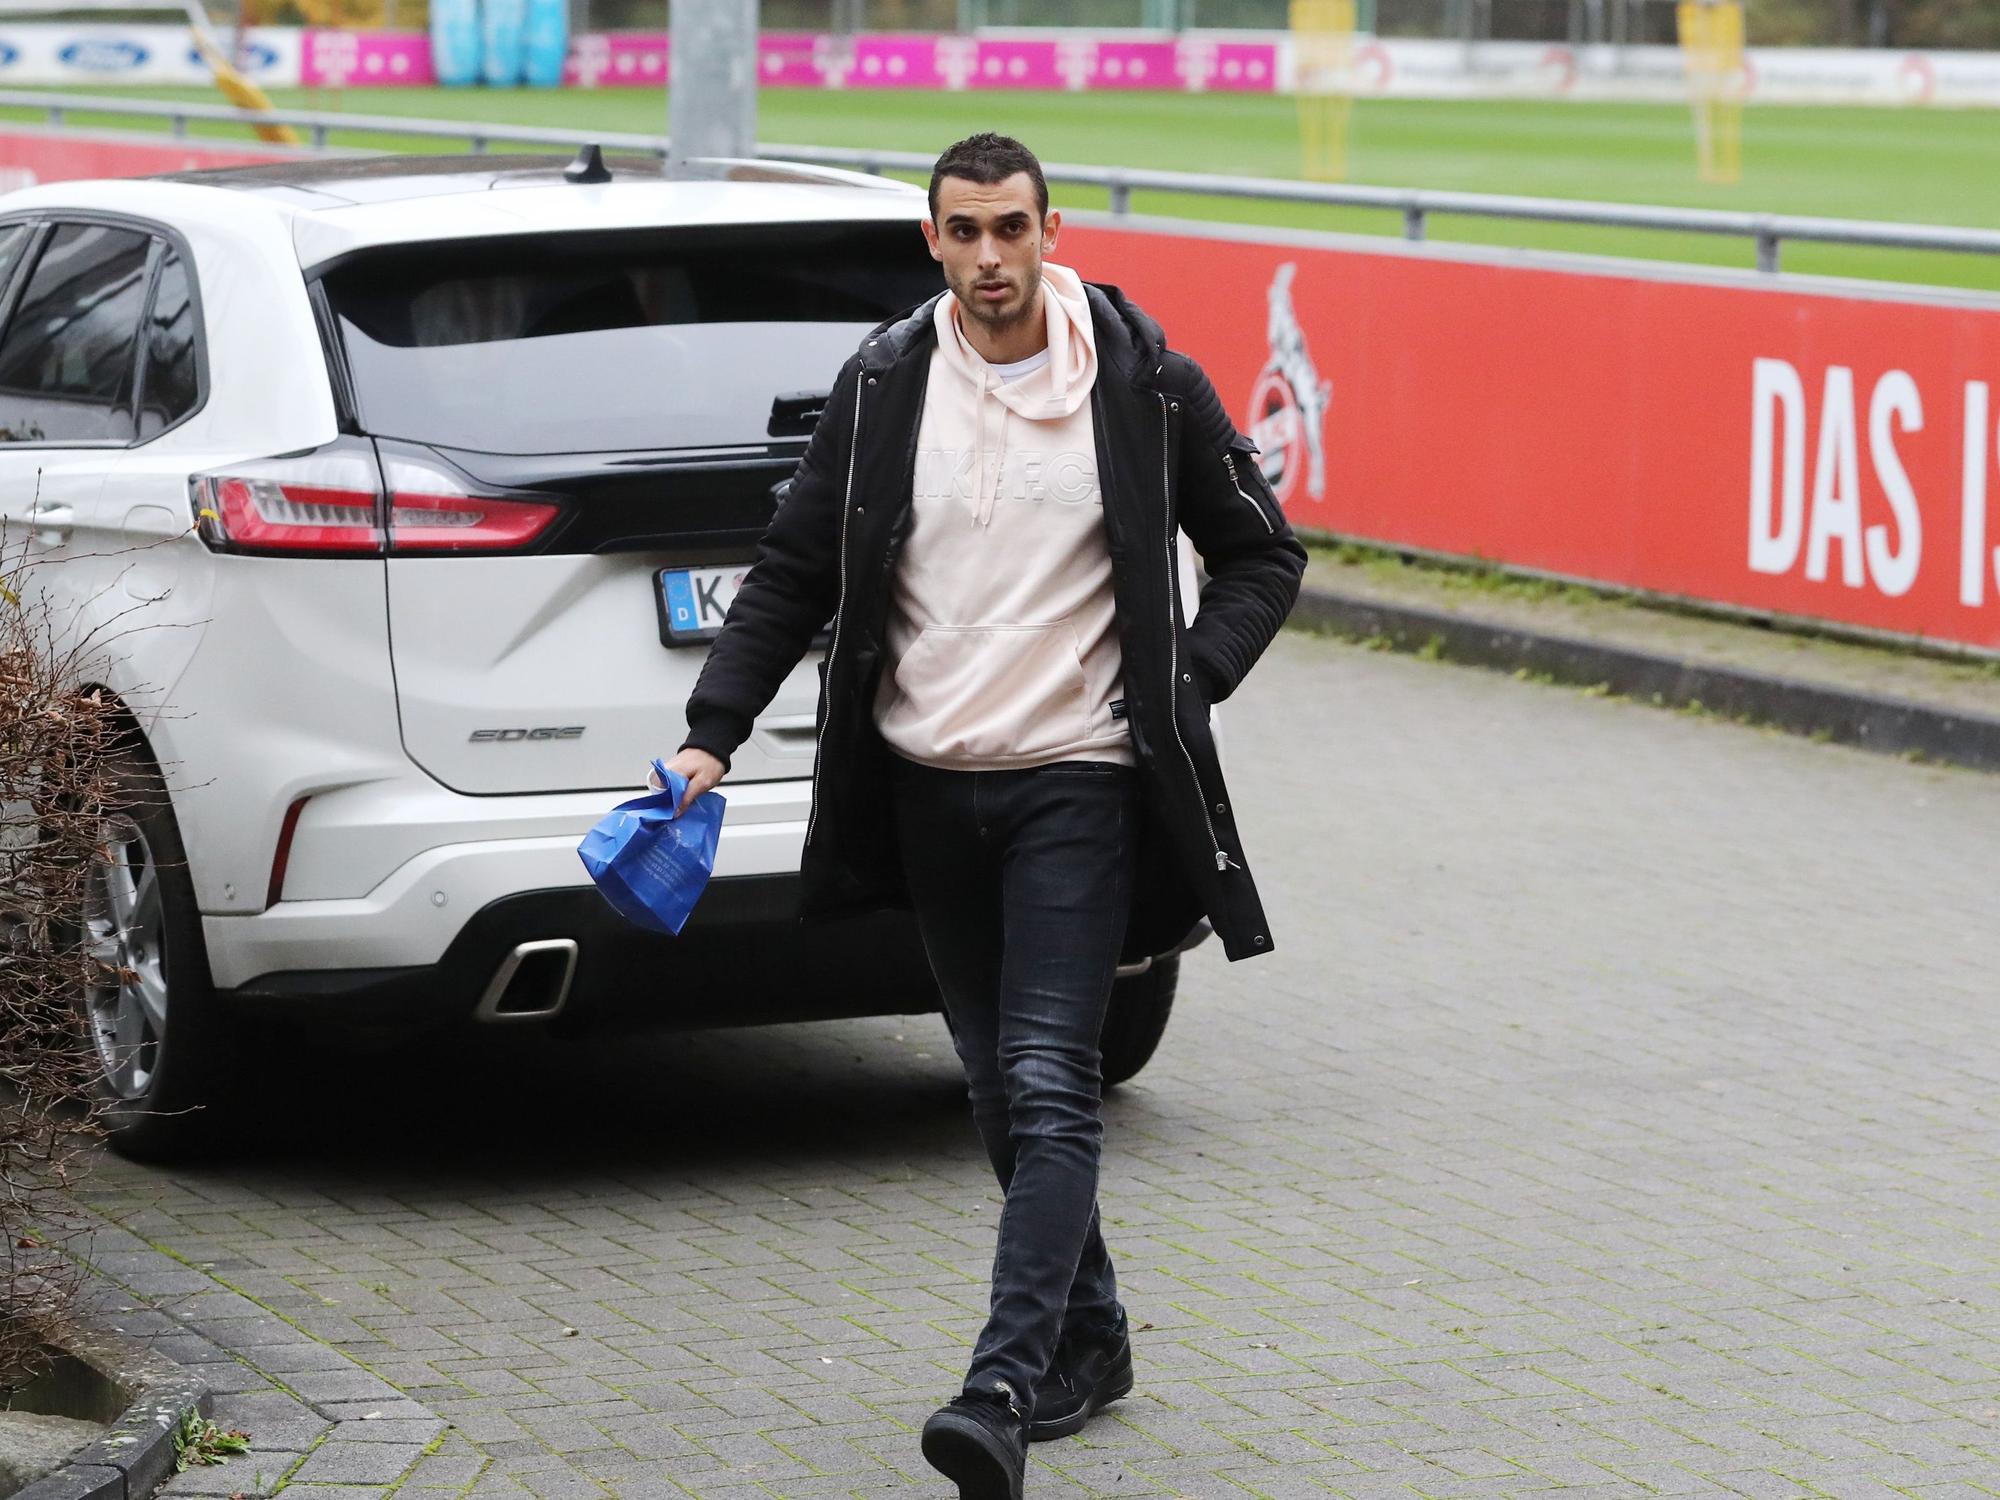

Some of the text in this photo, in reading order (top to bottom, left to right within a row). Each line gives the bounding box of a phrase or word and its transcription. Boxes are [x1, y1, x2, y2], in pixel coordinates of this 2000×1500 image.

[1748, 357, 2000, 607] DAS I
[677, 607, 689, 621] D
[468, 726, 586, 743] EDGE
